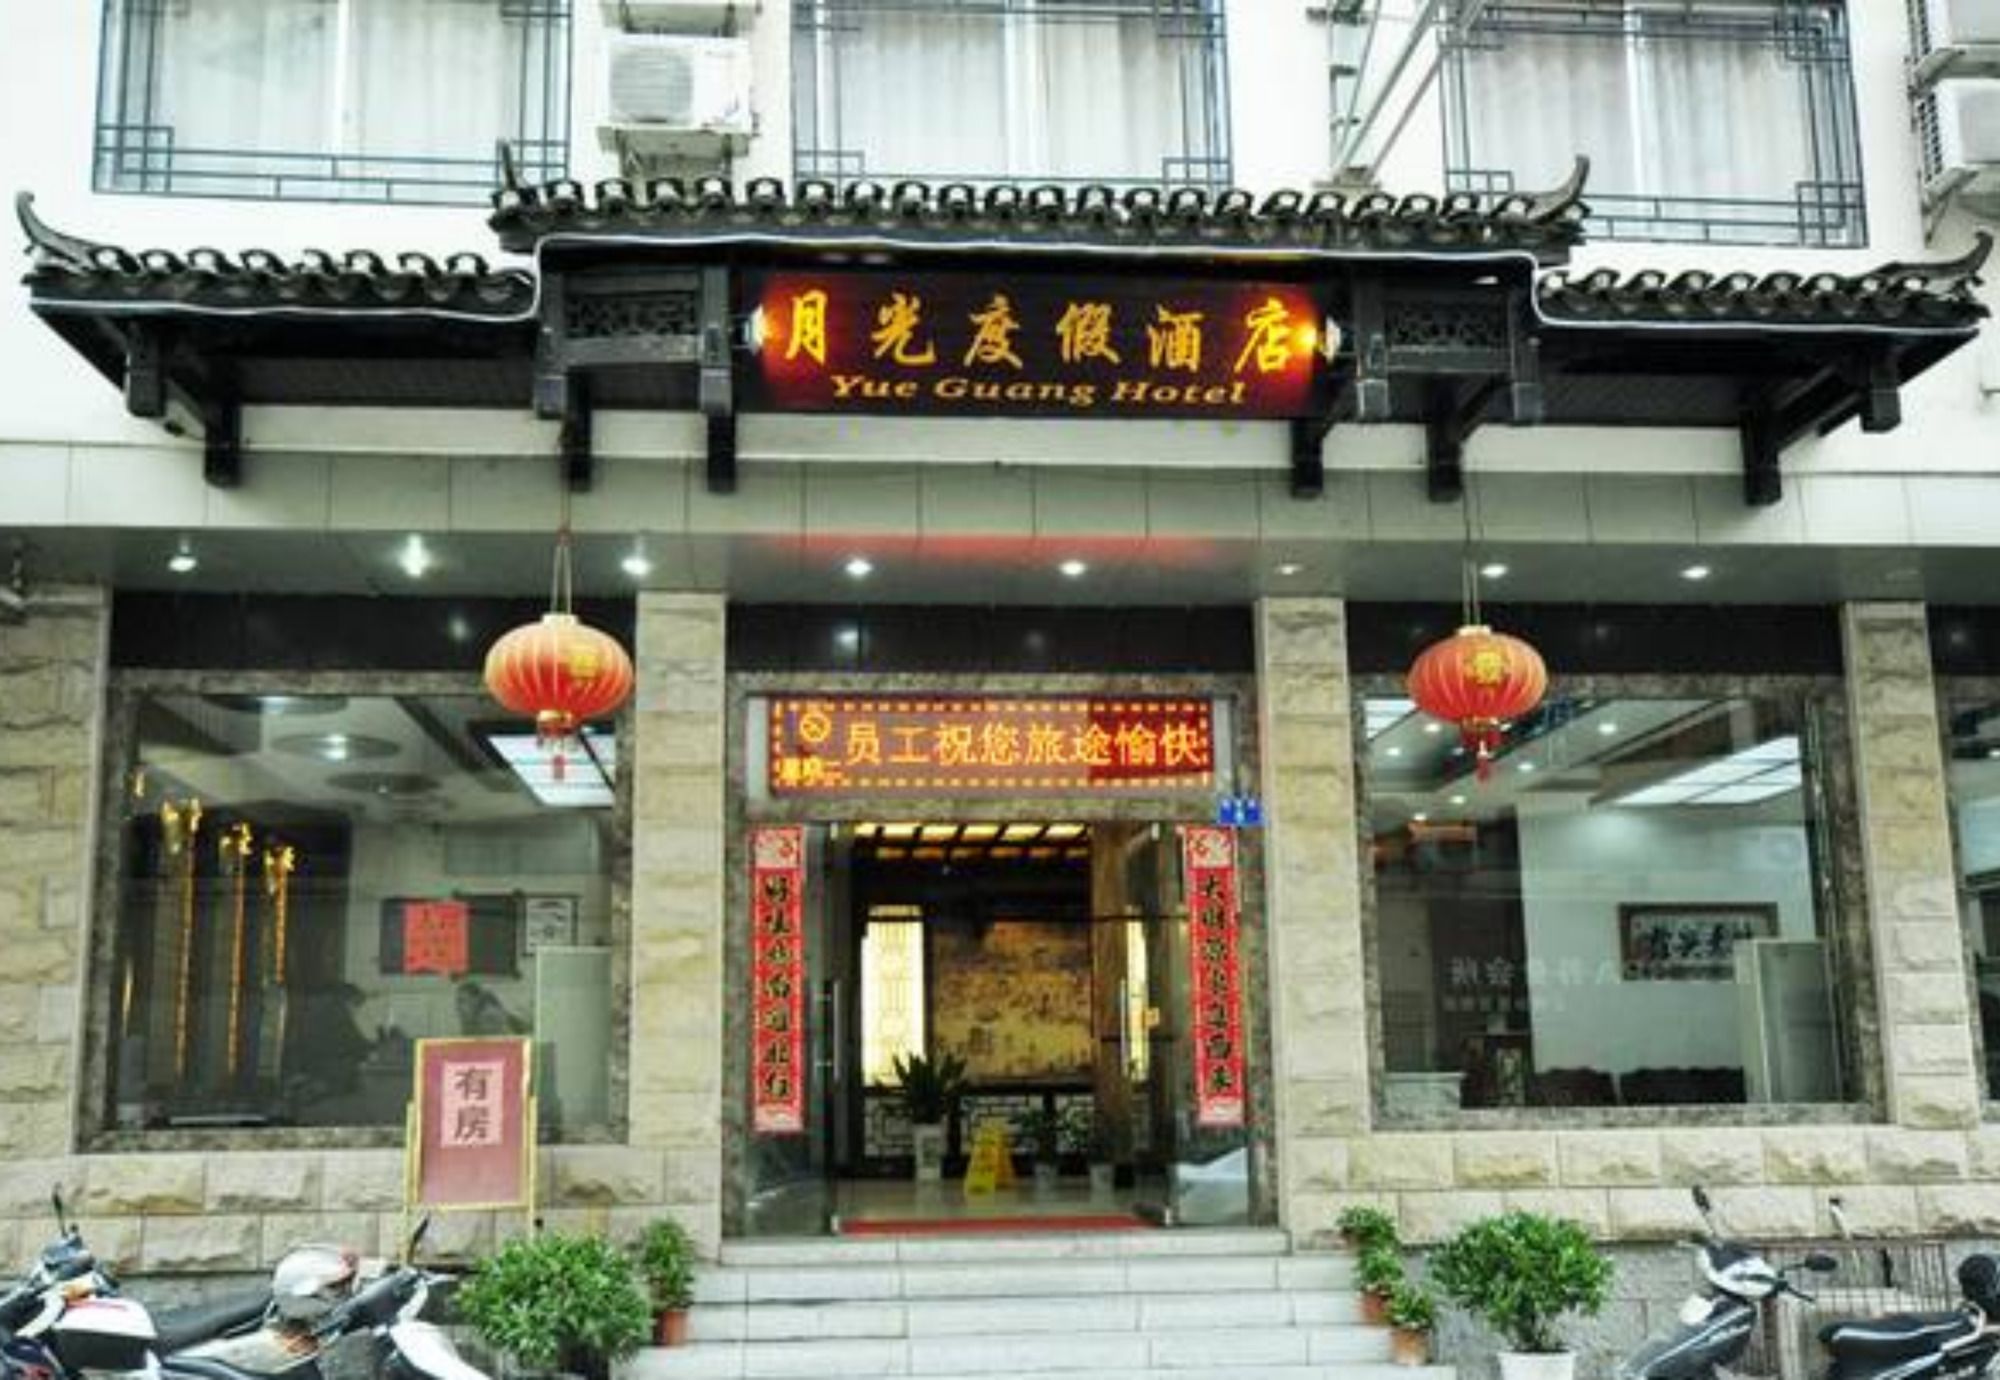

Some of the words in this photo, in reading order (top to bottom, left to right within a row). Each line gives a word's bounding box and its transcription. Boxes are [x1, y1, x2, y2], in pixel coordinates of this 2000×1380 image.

[785, 289, 1296, 374] 月光度假酒店
[831, 375, 919, 399] Yue
[934, 377, 1096, 405] Guang
[1110, 380, 1247, 405] Hotel
[845, 719, 1202, 767] 员工祝您旅途愉快
[454, 1066, 493, 1140] 有房
